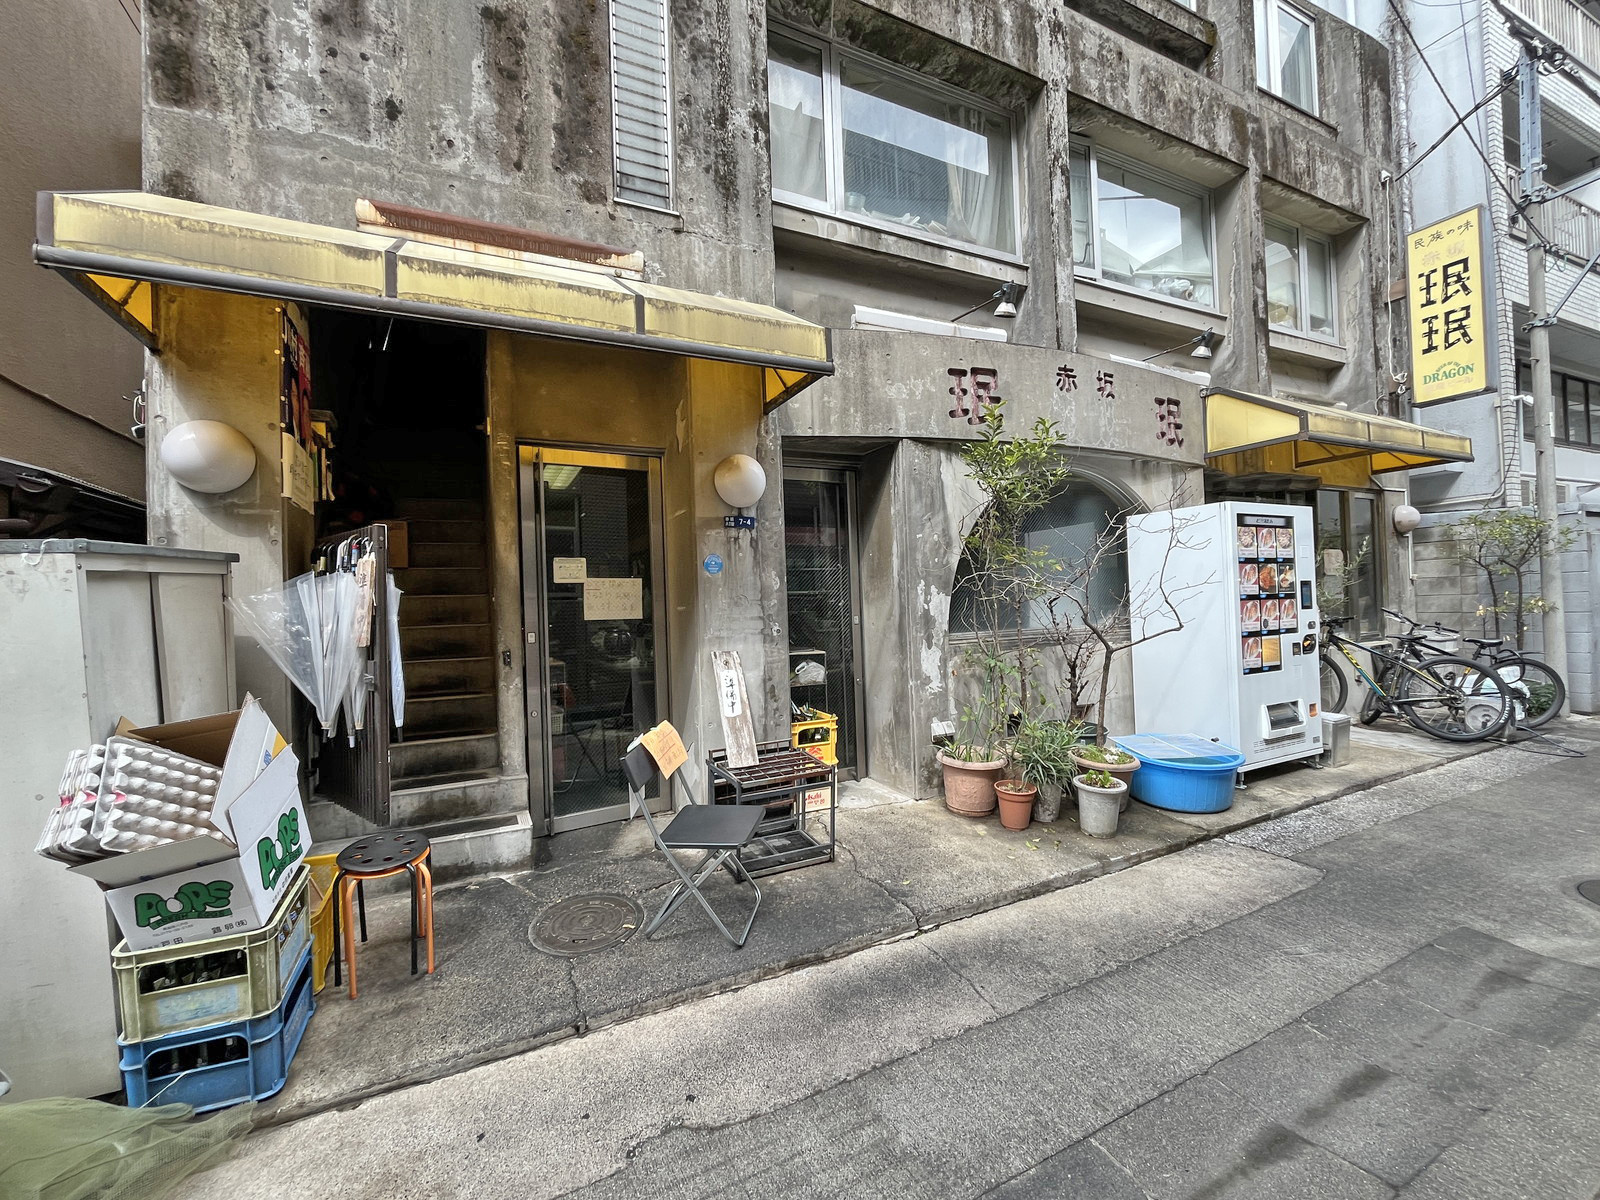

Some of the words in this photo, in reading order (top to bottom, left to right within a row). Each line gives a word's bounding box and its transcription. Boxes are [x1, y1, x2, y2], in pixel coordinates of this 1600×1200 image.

[1414, 219, 1474, 249] 民族の味
[1417, 256, 1474, 356] 珉珉
[1056, 363, 1116, 400] 赤坂
[1423, 362, 1475, 385] DRAGON
[738, 518, 752, 527] 7-4
[723, 674, 738, 714] 準備中
